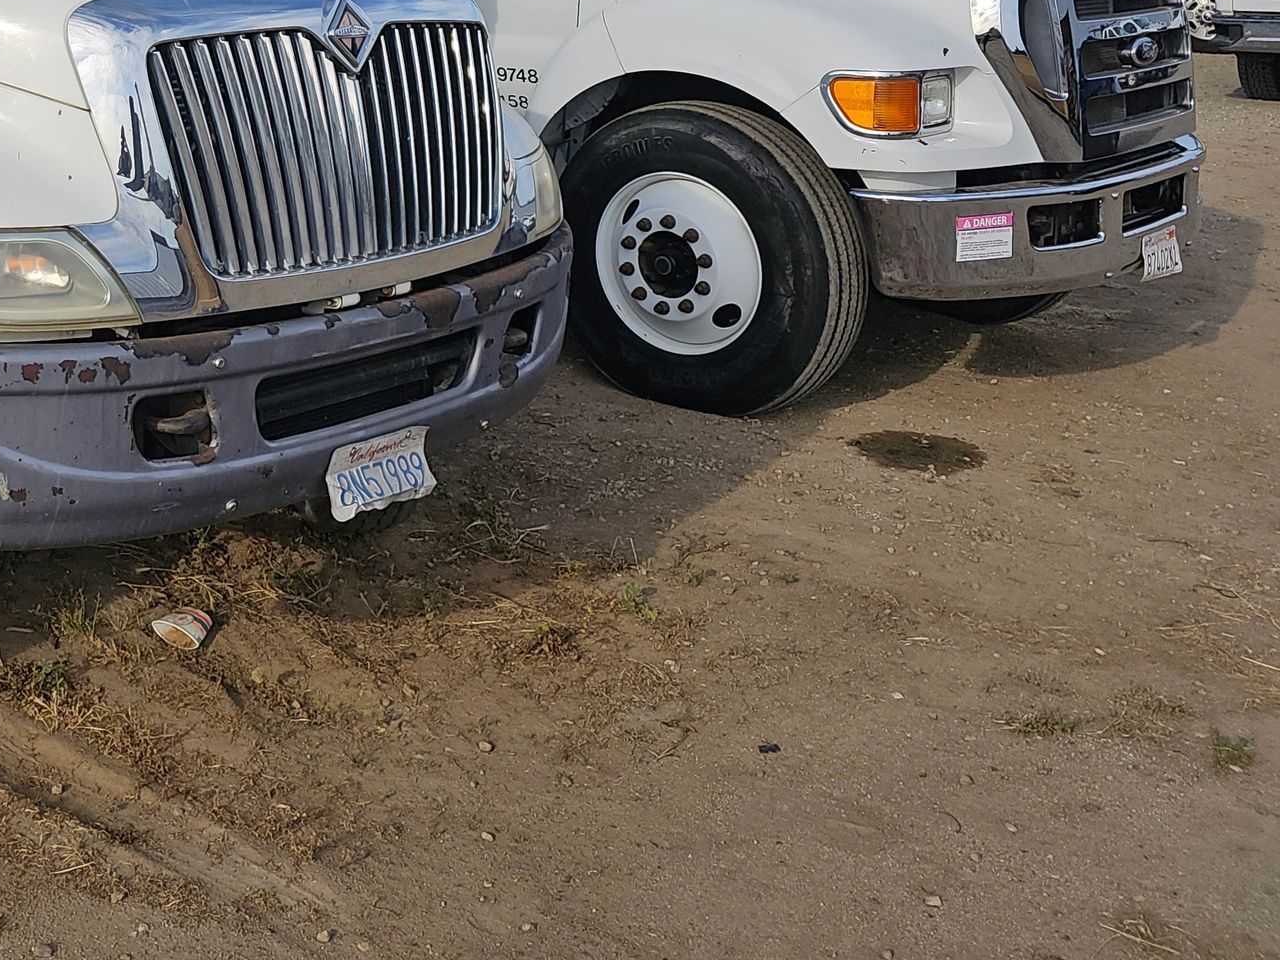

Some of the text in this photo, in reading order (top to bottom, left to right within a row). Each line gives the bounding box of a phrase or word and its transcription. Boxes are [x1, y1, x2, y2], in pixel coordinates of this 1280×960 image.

[973, 216, 1007, 228] DANGER
[350, 438, 414, 463] California
[337, 451, 425, 506] 8N57989
